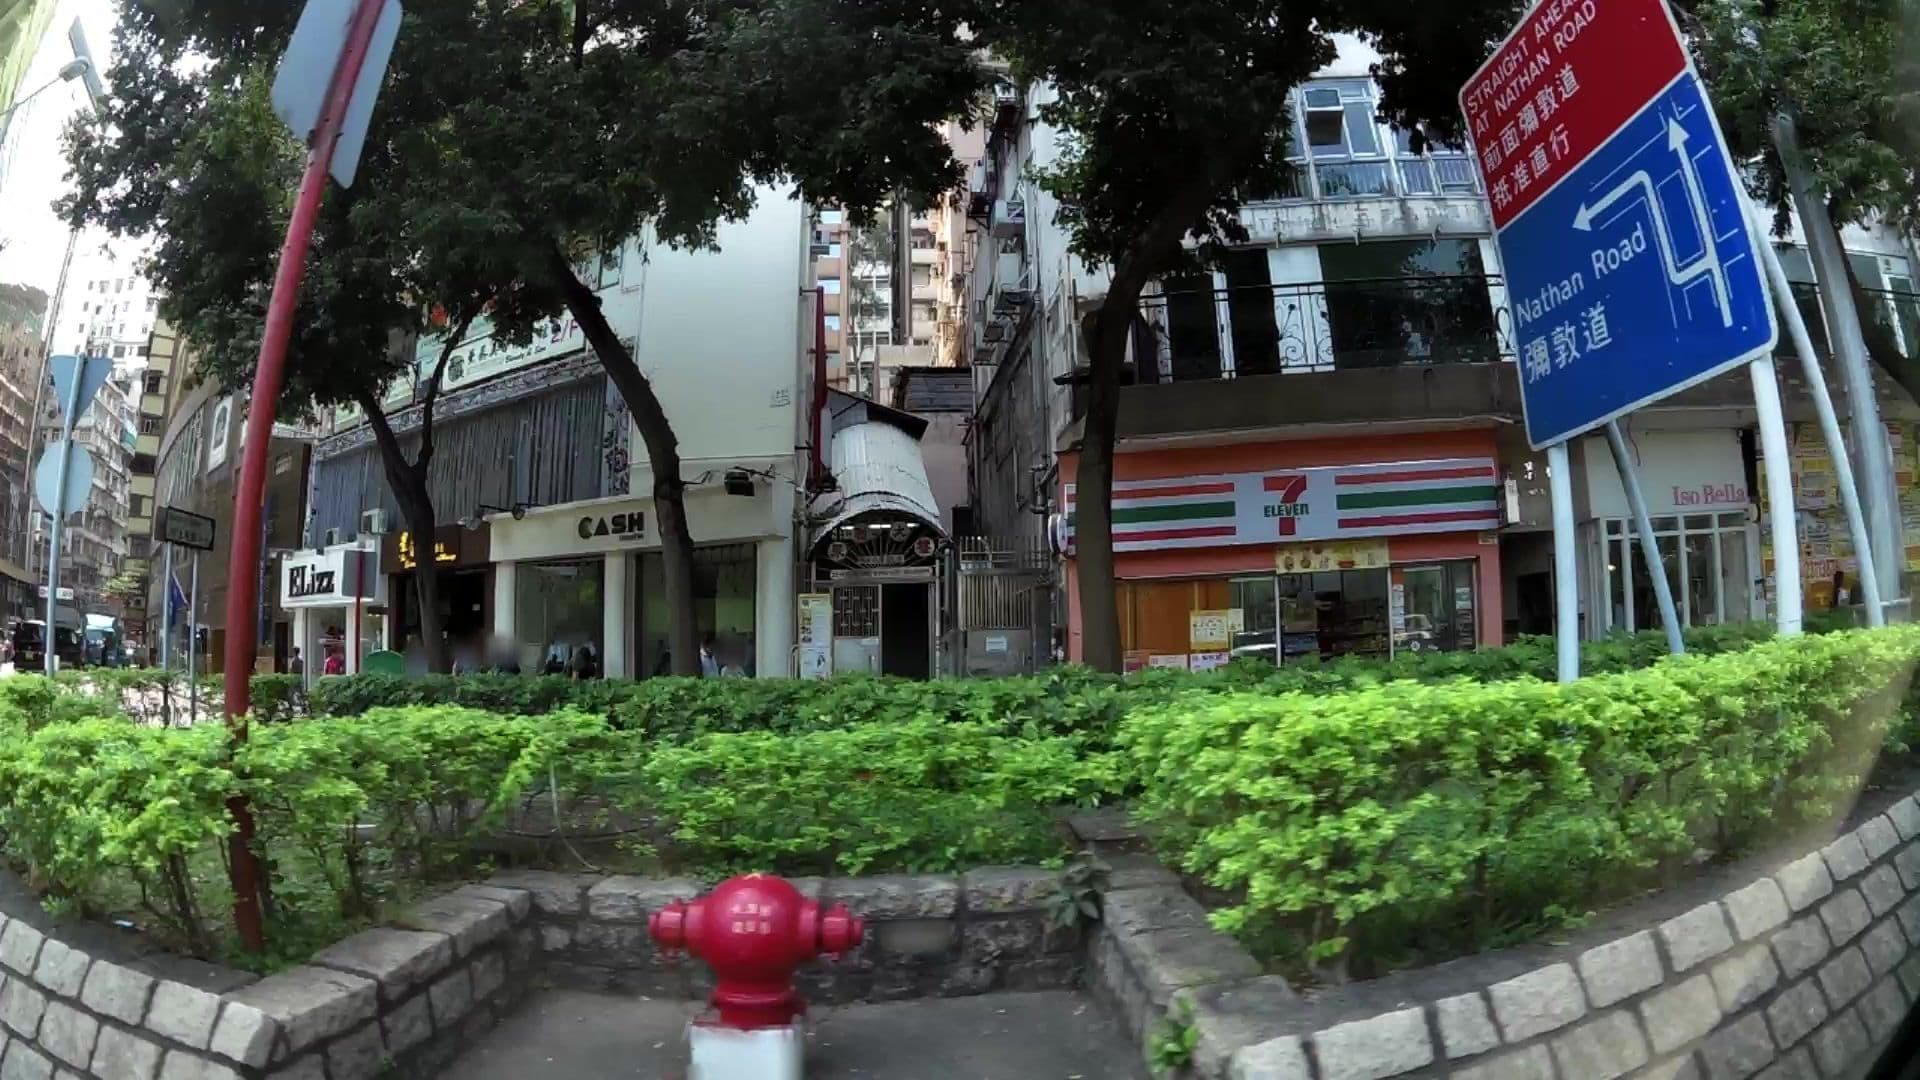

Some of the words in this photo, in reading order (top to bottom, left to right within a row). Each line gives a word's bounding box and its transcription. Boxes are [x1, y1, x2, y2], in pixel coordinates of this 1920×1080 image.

[1467, 37, 1529, 115] STRAIGHT
[1534, 0, 1578, 44] AHEA
[1475, 111, 1491, 139] AT
[1494, 47, 1550, 117] NATHAN
[1553, 0, 1596, 54] ROAD
[1482, 62, 1580, 174] 前面彌敦道
[1516, 271, 1585, 329] Nathan
[1591, 220, 1647, 280] Road
[1524, 301, 1613, 385] 彌敦道
[578, 511, 645, 540] CASH
[1671, 485, 1700, 506] Iso
[1702, 483, 1746, 505] Bella
